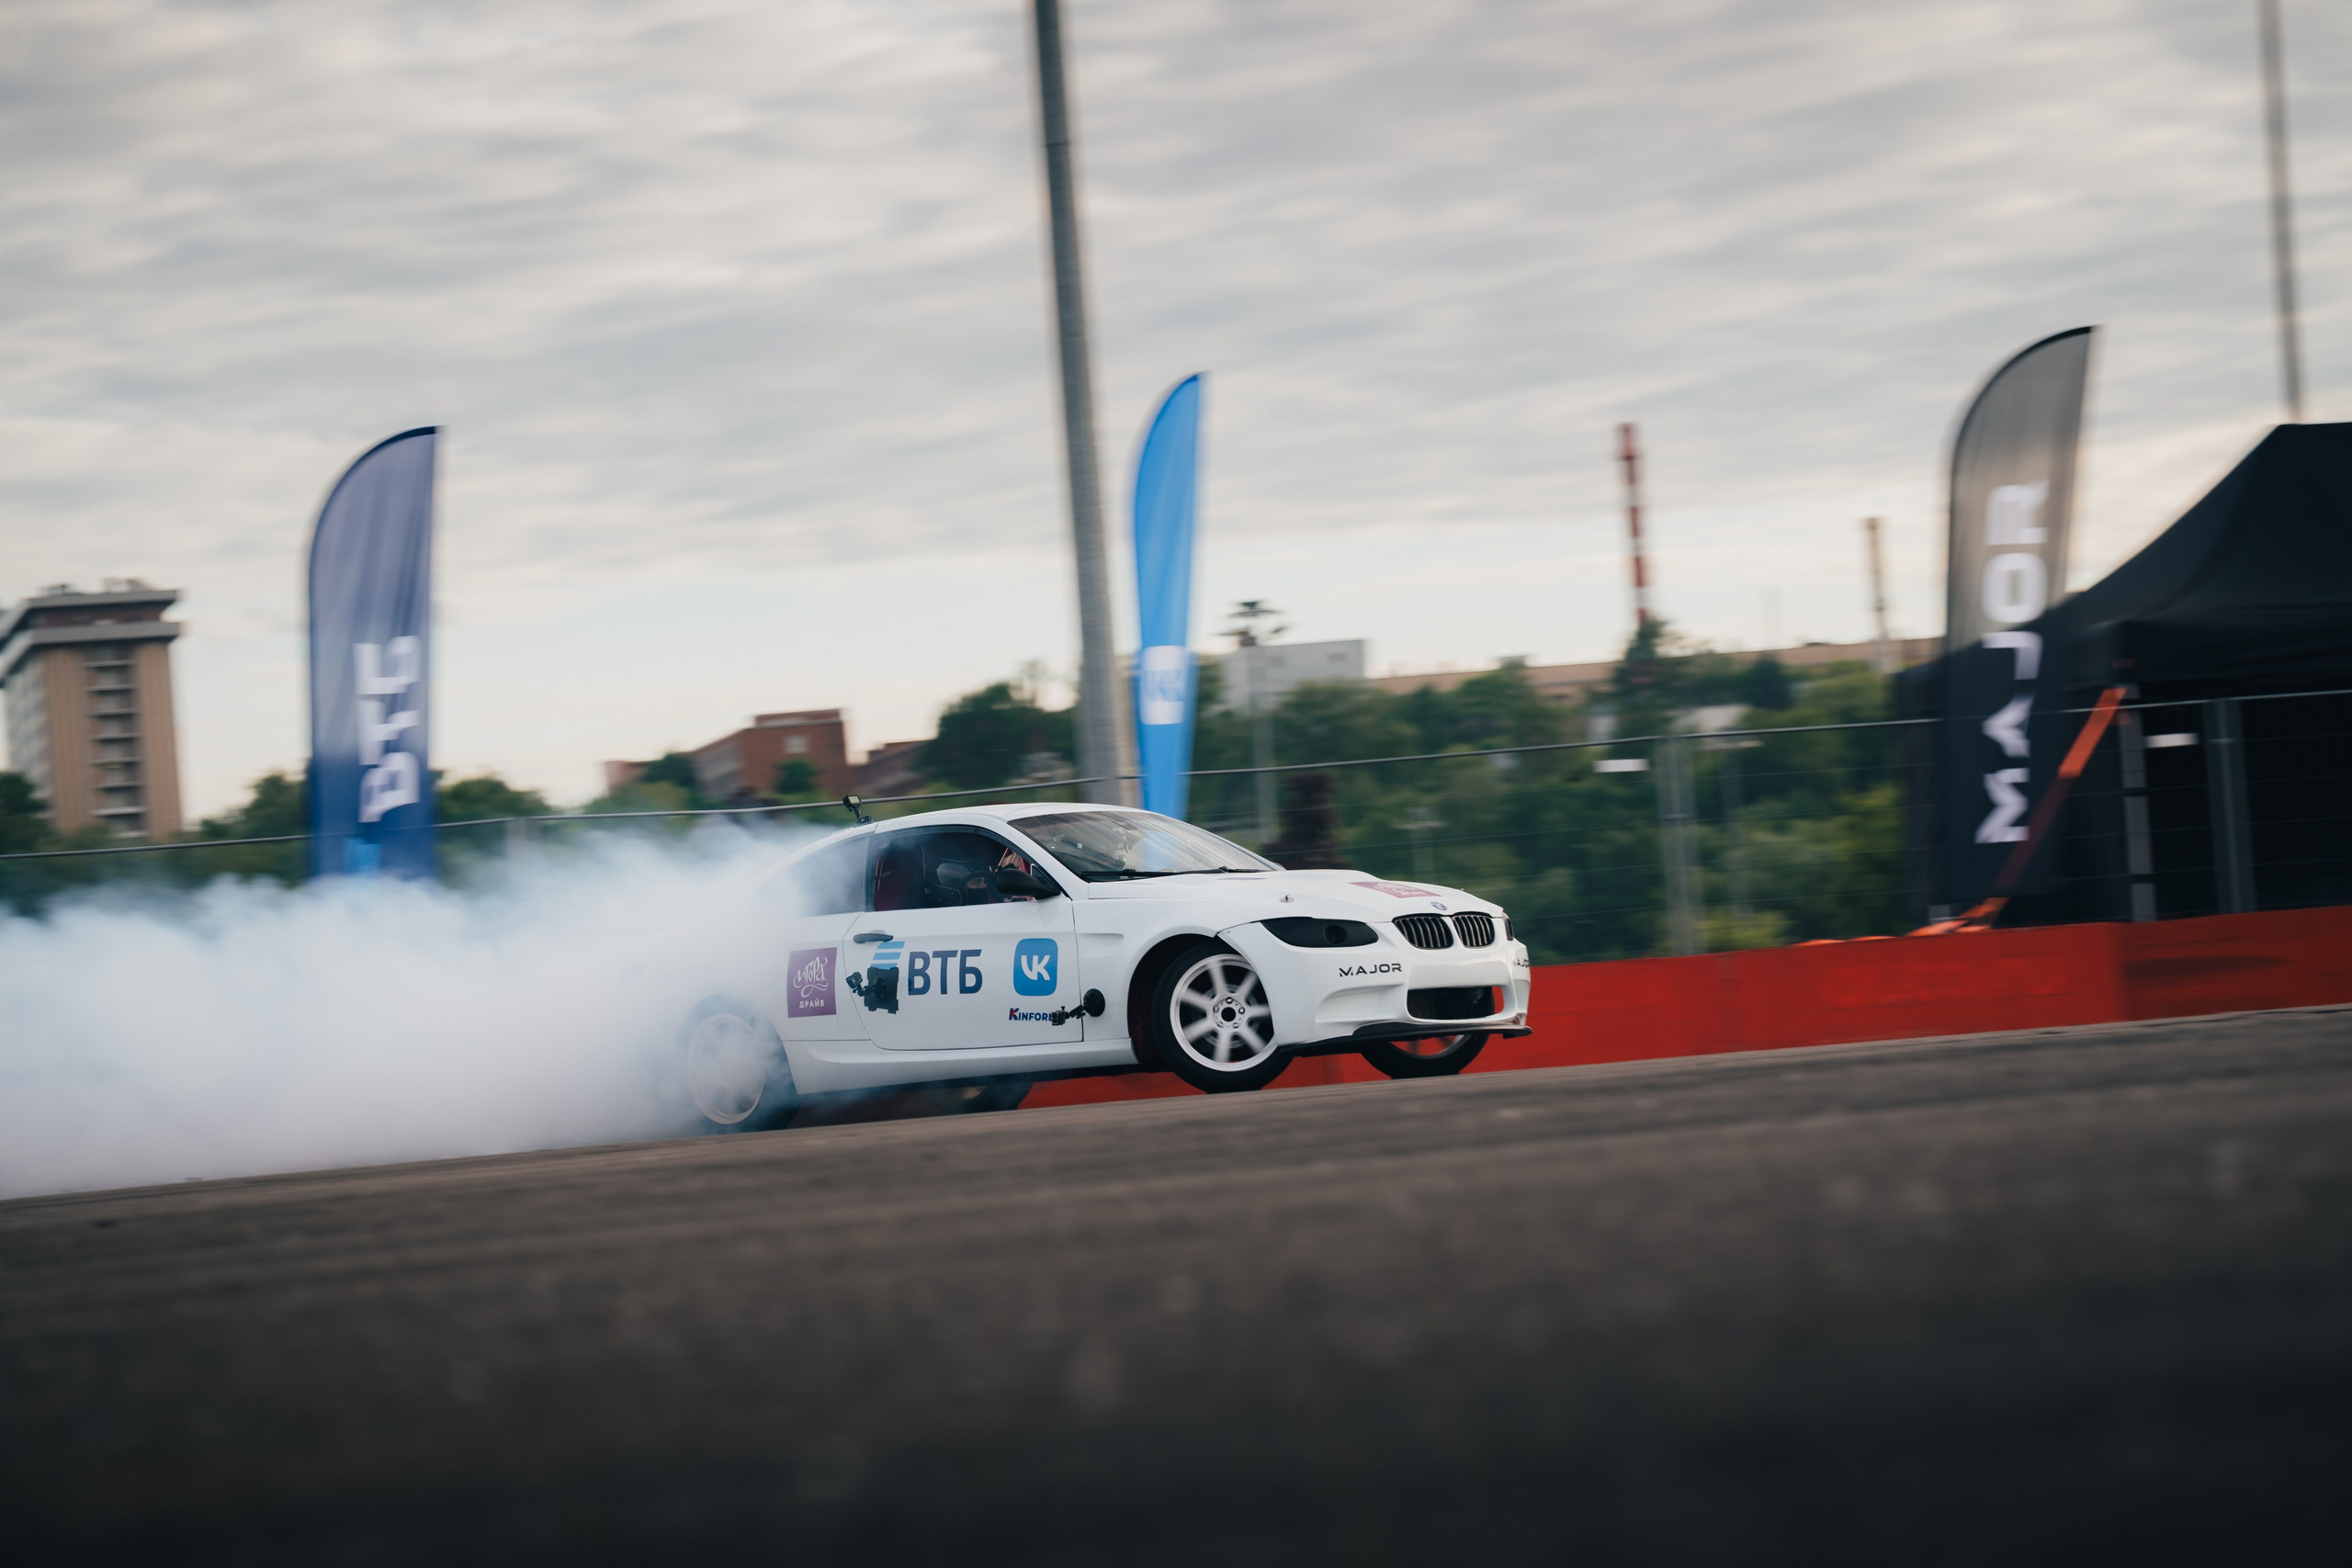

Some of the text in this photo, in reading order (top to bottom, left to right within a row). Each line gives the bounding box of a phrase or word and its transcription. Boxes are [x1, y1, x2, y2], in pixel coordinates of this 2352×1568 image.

[1975, 481, 2050, 843] MAJOR
[354, 635, 420, 823] ВТБ
[908, 949, 983, 996] ВТБ
[1021, 954, 1051, 981] VK
[1338, 963, 1402, 977] MAJOR
[798, 998, 825, 1009] ДРАЙВ
